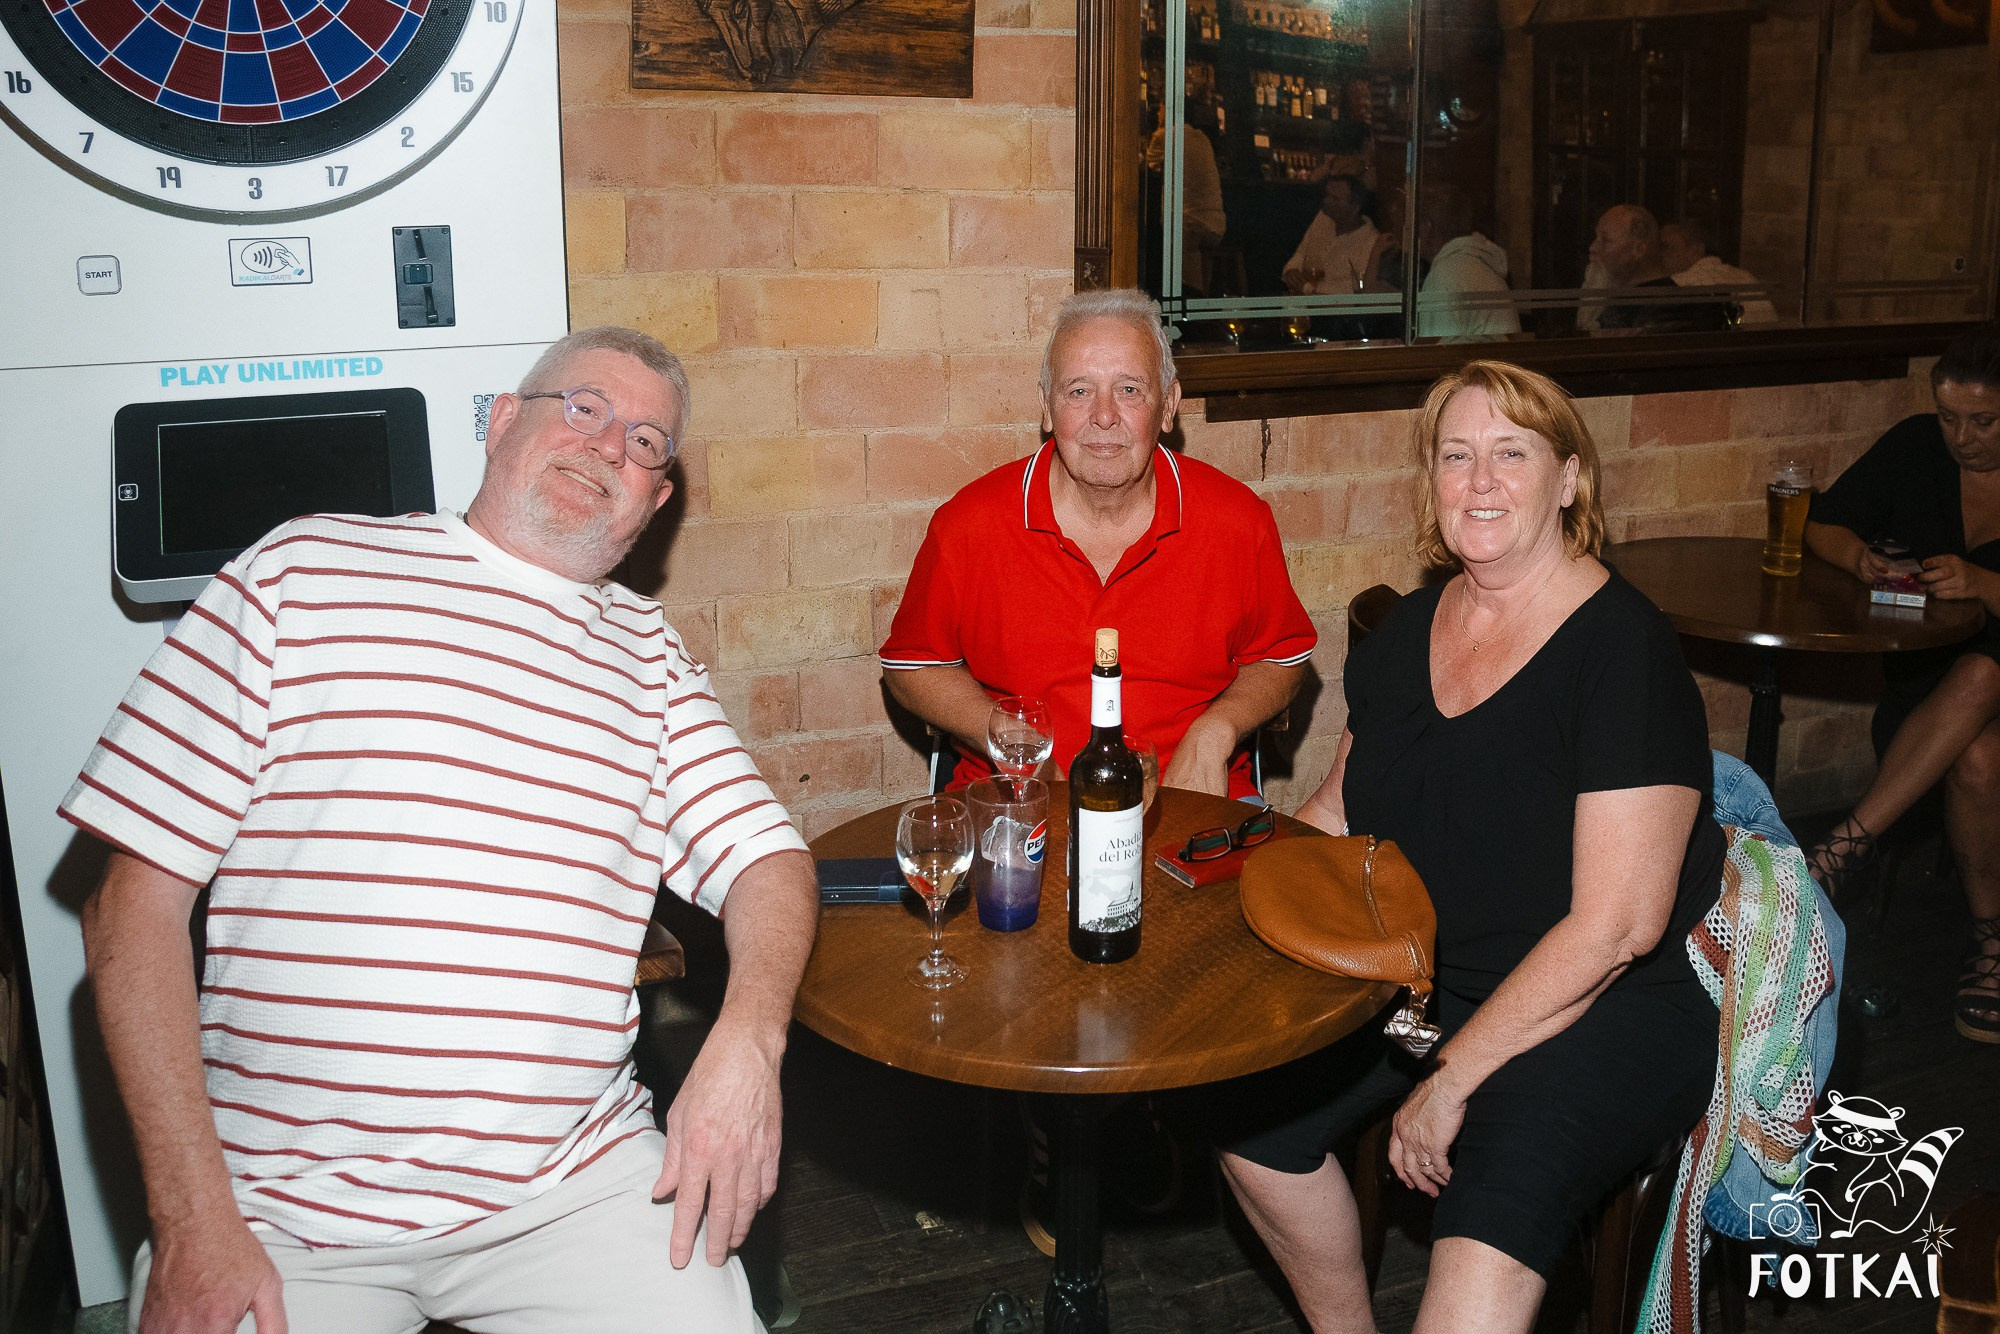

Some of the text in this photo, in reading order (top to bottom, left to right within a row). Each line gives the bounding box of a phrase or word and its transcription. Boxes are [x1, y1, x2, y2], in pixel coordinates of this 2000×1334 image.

[484, 1, 507, 23] 10
[4, 70, 32, 94] 16
[450, 72, 474, 93] 15
[79, 132, 95, 154] 7
[400, 126, 415, 148] 2
[156, 166, 182, 189] 19
[325, 165, 349, 187] 17
[248, 177, 262, 200] 3
[85, 270, 113, 279] START
[160, 356, 384, 387] PLAY UNLIMITED
[1099, 851, 1120, 863] del
